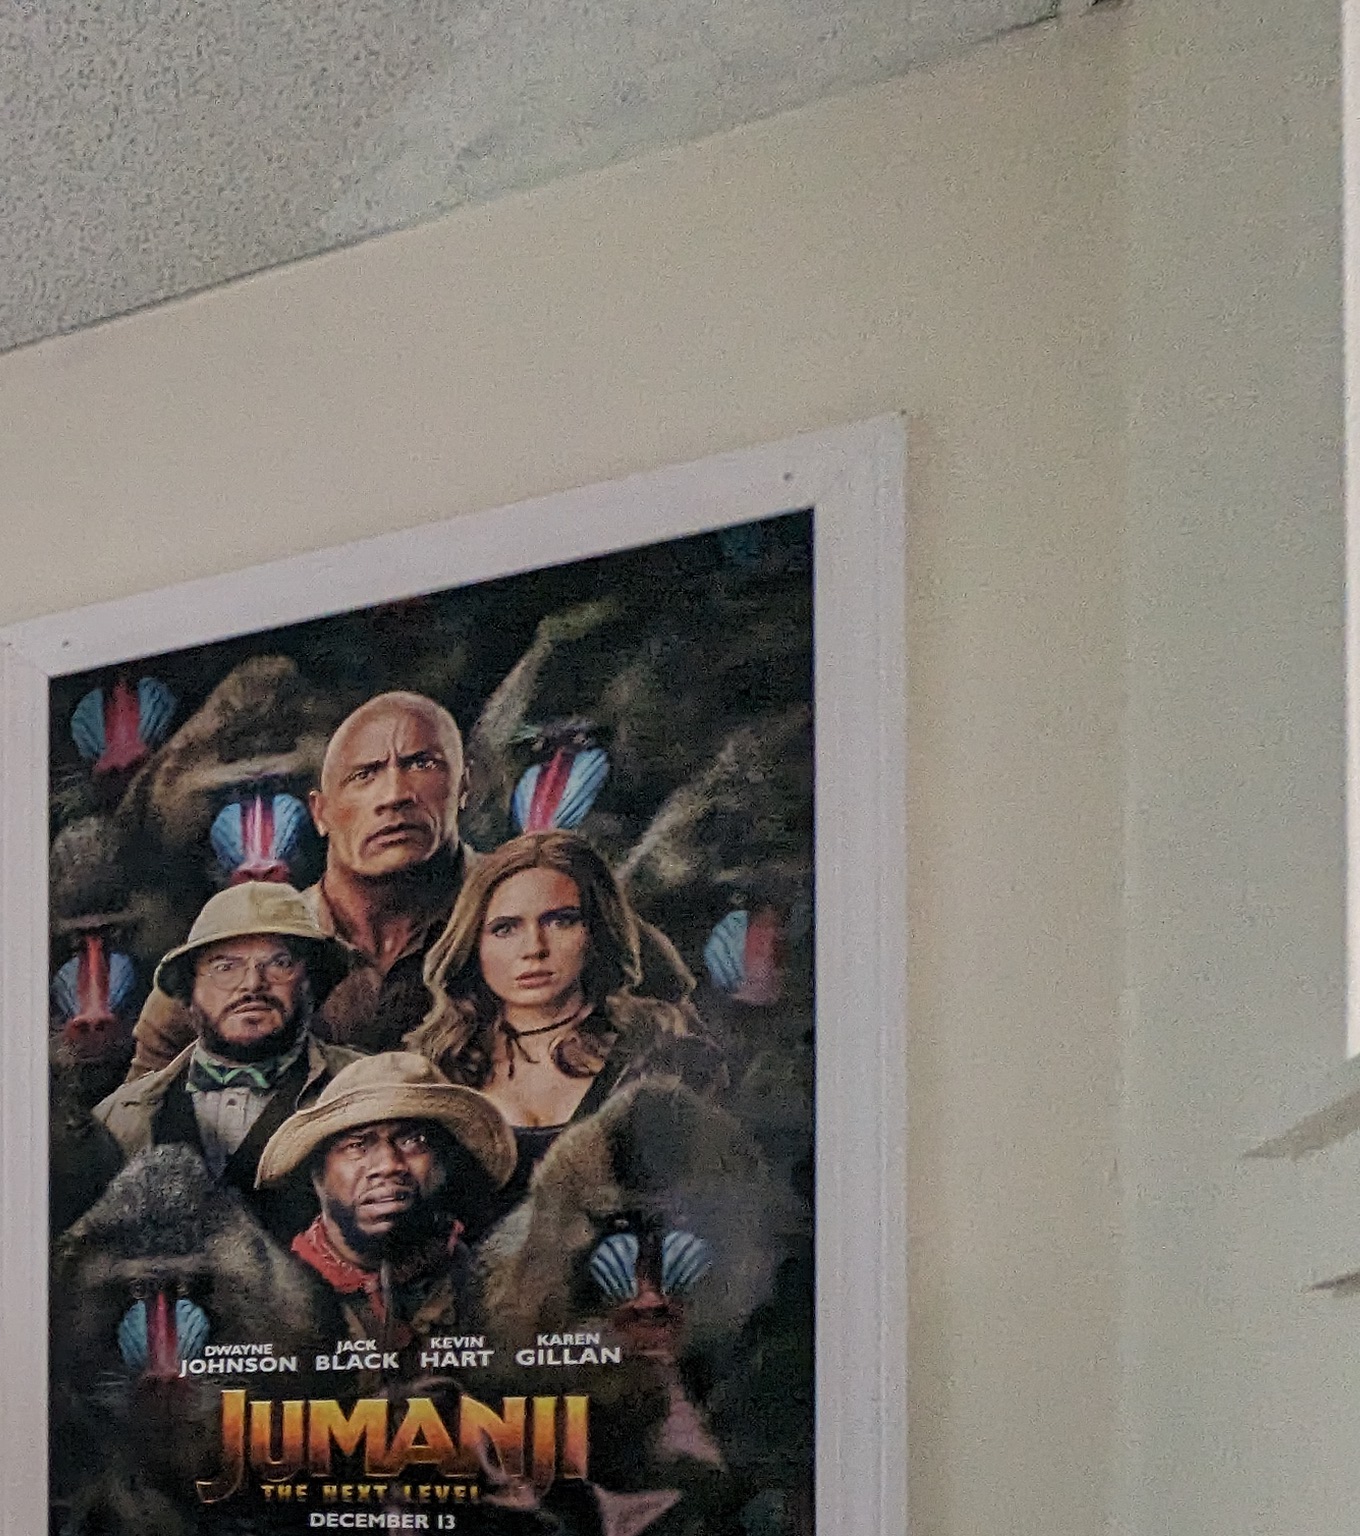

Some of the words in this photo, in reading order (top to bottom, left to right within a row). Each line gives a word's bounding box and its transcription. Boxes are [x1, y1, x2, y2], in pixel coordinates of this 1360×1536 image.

[335, 1339, 377, 1354] JACK
[430, 1335, 485, 1349] KEVIN
[536, 1333, 600, 1347] KAREN
[204, 1343, 274, 1357] DWAYNE
[515, 1347, 621, 1366] GILLAN
[178, 1356, 298, 1377] JOHNSON
[315, 1352, 400, 1372] BLACK
[420, 1350, 495, 1369] HART
[196, 1389, 590, 1503] JUMANJI
[260, 1484, 308, 1502] THE
[323, 1484, 388, 1502] NEXT
[403, 1484, 479, 1502] LEVEL
[310, 1512, 429, 1529] DECEMBER
[437, 1513, 456, 1530] 13
